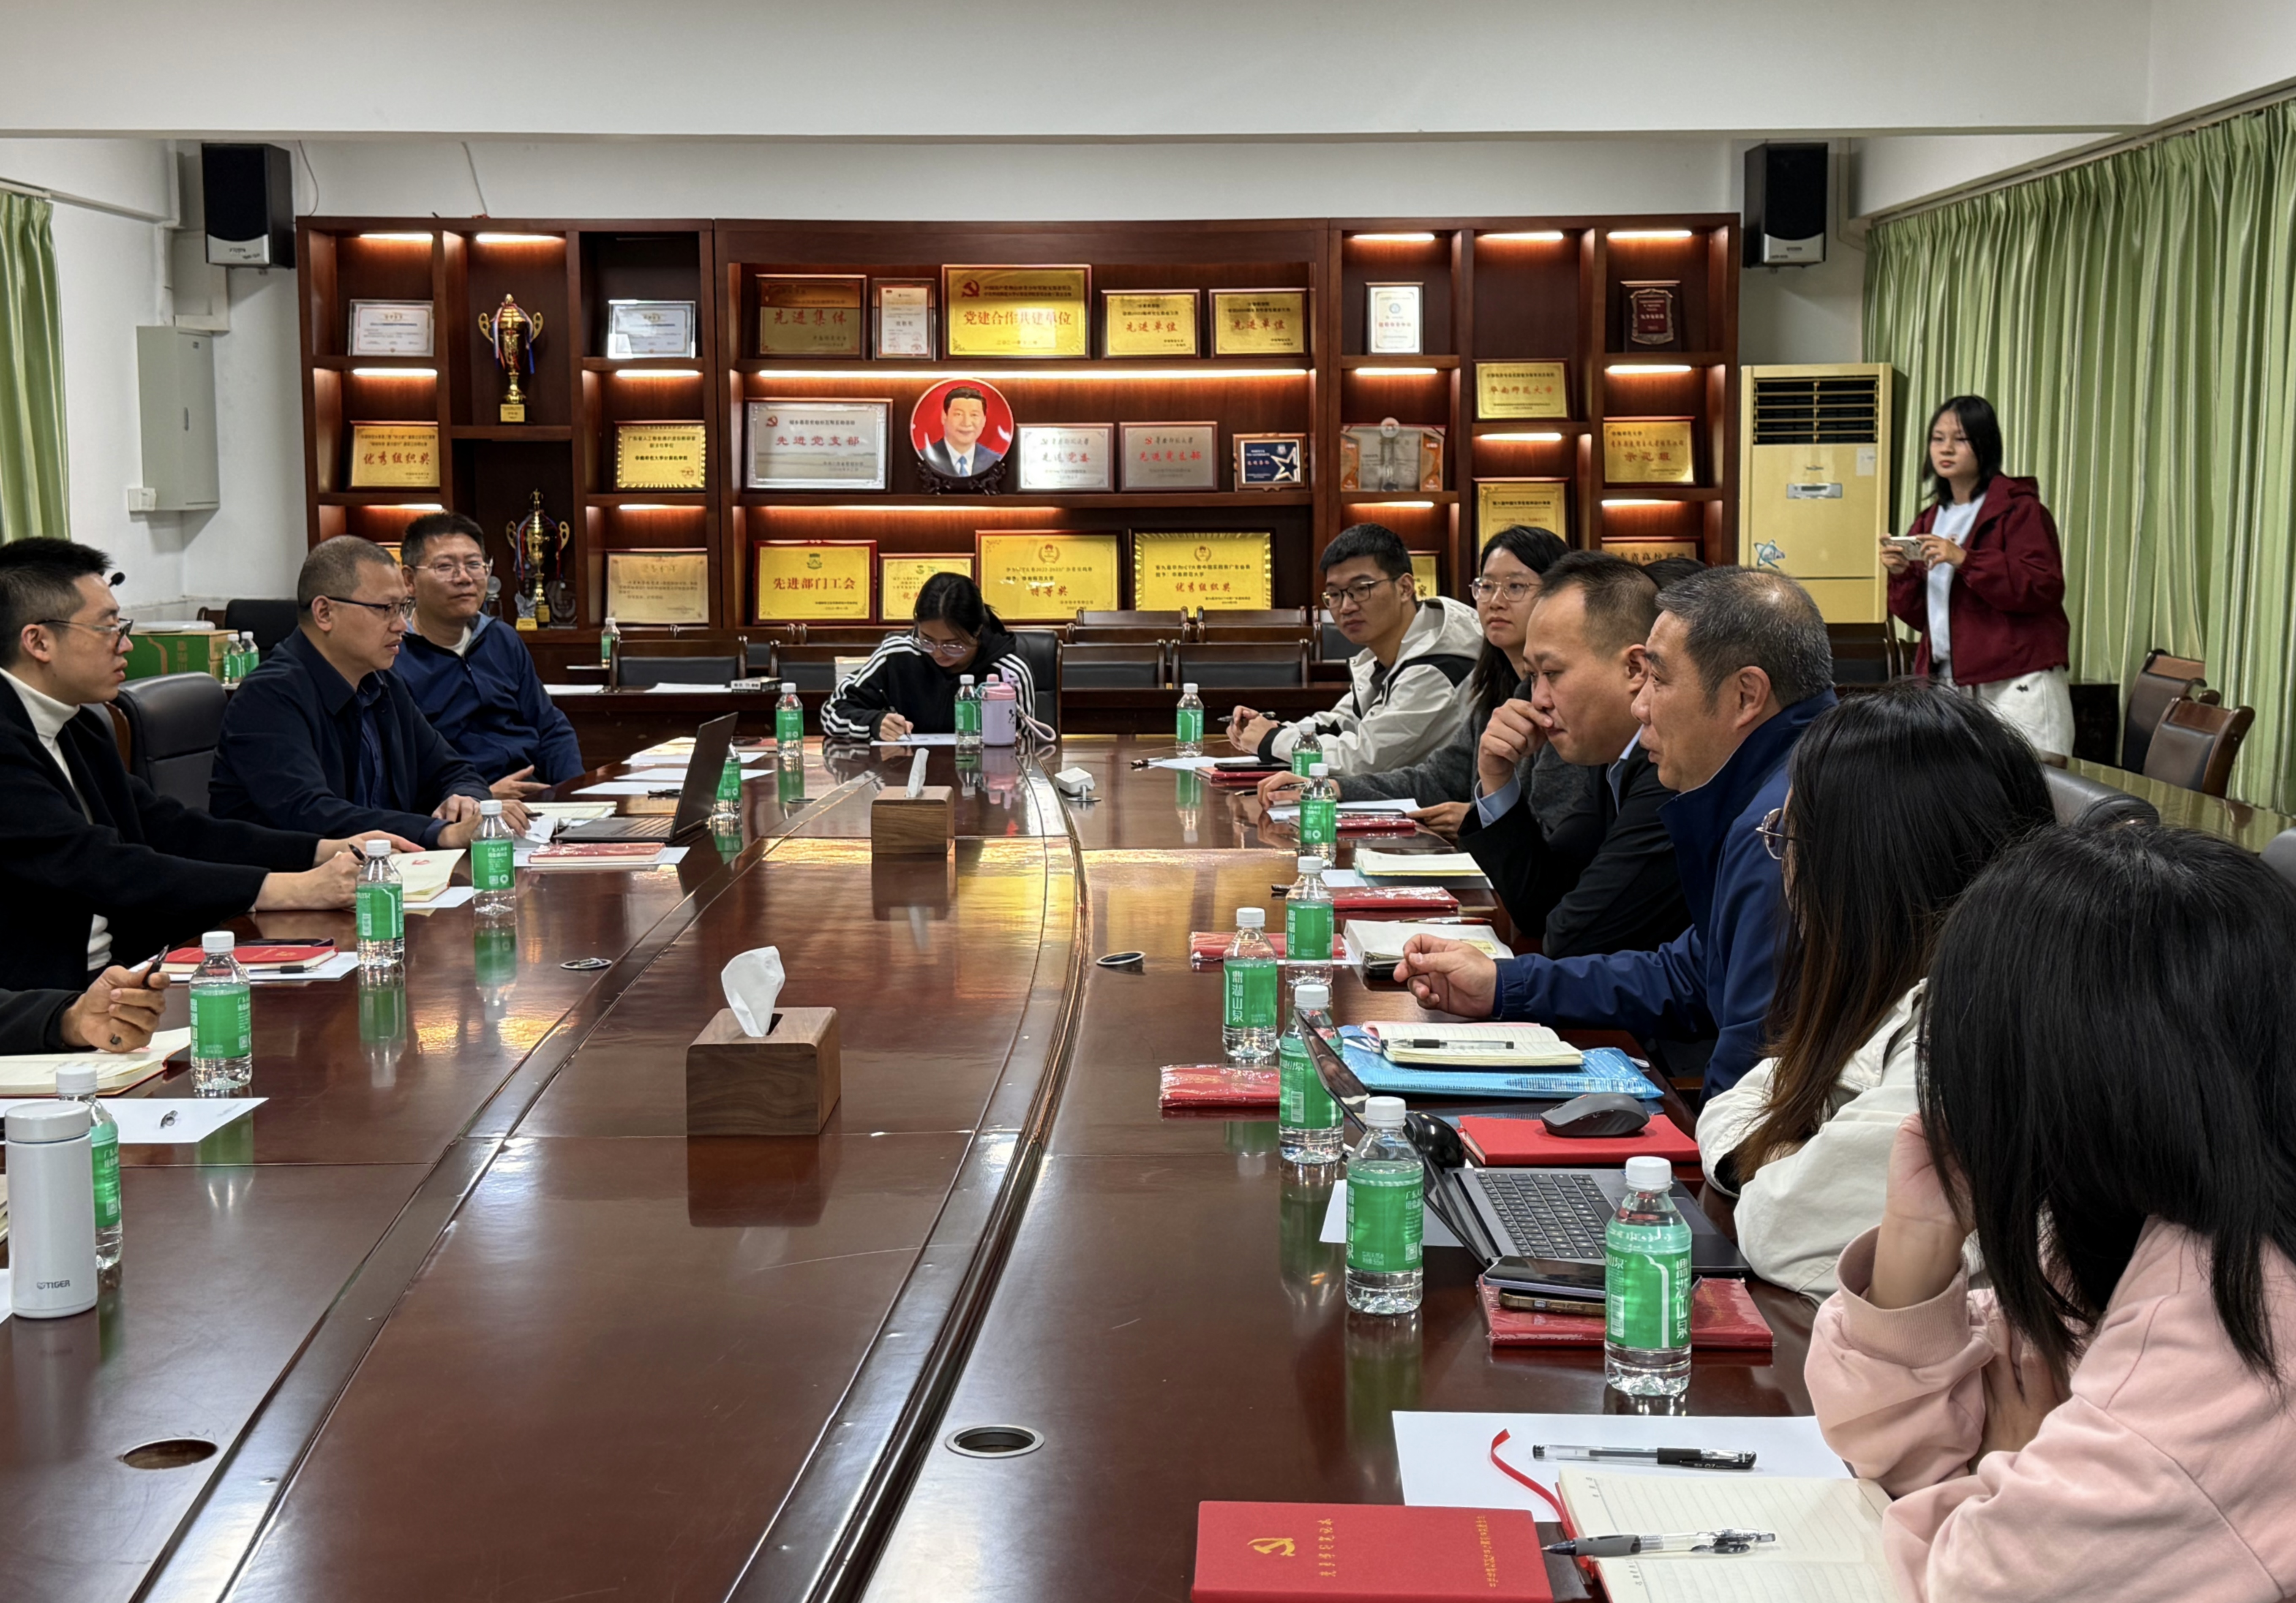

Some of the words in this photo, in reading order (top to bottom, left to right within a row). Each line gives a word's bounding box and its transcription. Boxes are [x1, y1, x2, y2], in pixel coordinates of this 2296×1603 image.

[774, 309, 847, 326] 先进集体
[964, 311, 1072, 326] 党建合作共建单位
[1126, 321, 1178, 332] 先进单位
[1234, 319, 1286, 331] 先进单位
[776, 435, 860, 446] 先进党支部
[363, 451, 431, 465] 优秀组织奖
[1140, 450, 1202, 463] 先进党支部
[773, 577, 856, 591] 先进部门工会
[1175, 581, 1232, 593] 优秀组织奖
[1287, 909, 1296, 955] 鼎湖山泉
[1232, 970, 1243, 1023] 鼎湖山泉
[46, 1279, 70, 1289] TIGER
[1676, 1257, 1688, 1339] 鼎湖山泉
